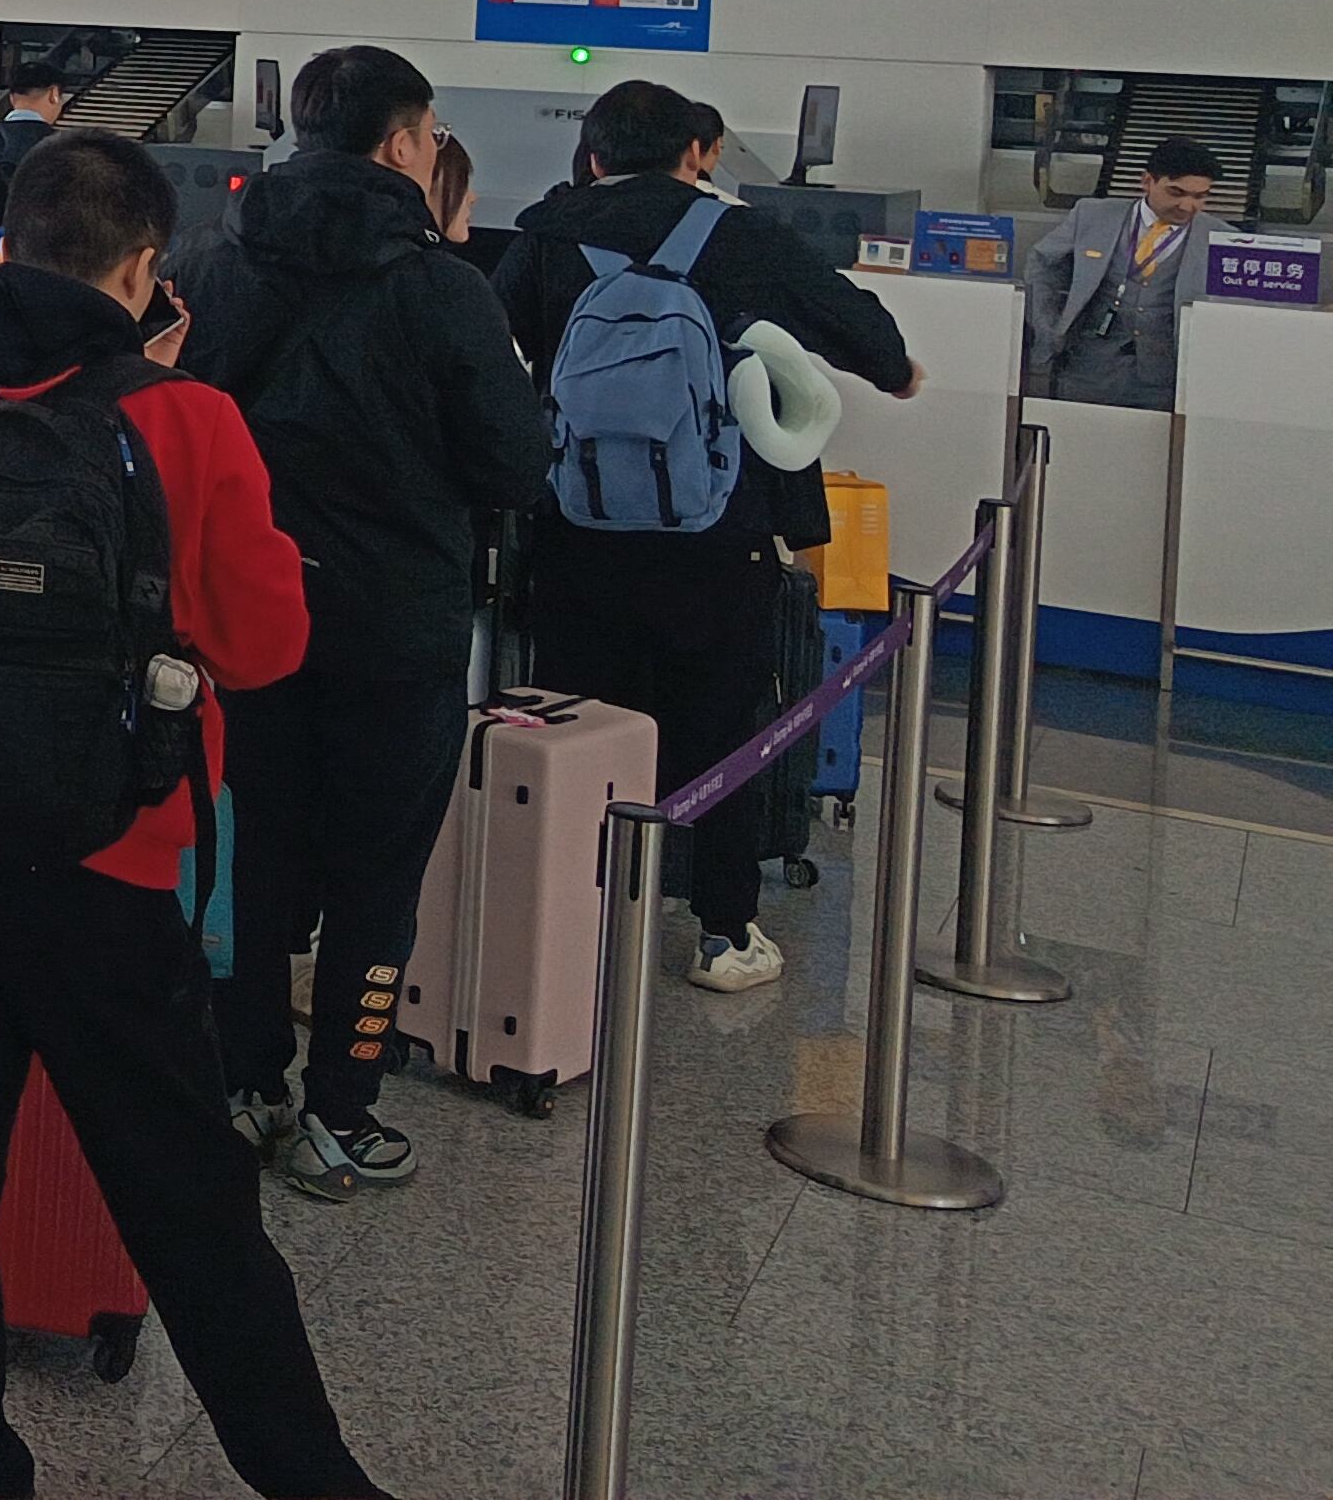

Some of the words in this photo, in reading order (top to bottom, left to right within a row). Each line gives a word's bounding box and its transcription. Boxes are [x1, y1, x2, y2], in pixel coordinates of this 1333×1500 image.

[555, 108, 585, 120] FIS
[1222, 257, 1304, 279] 暂停服务
[1222, 276, 1242, 285] Out
[1246, 278, 1259, 287] of
[1263, 280, 1302, 290] service
